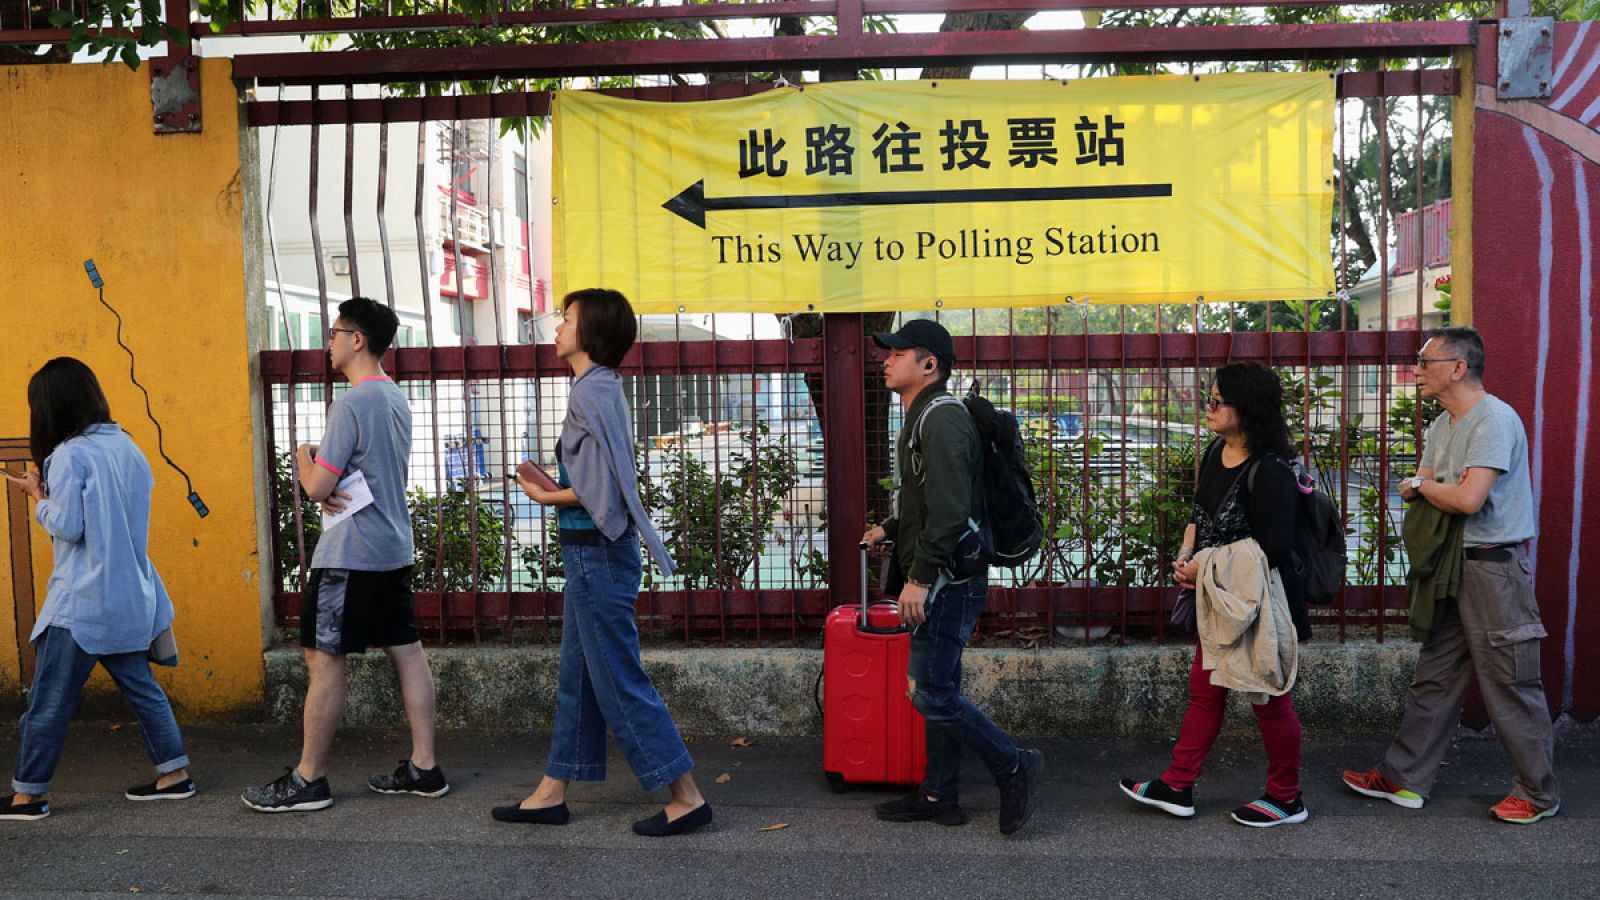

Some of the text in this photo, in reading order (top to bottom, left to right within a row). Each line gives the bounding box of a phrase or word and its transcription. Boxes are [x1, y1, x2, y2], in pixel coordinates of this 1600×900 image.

[738, 114, 1125, 180] 此路往投票站
[711, 226, 1160, 270] This Way to Polling Station
